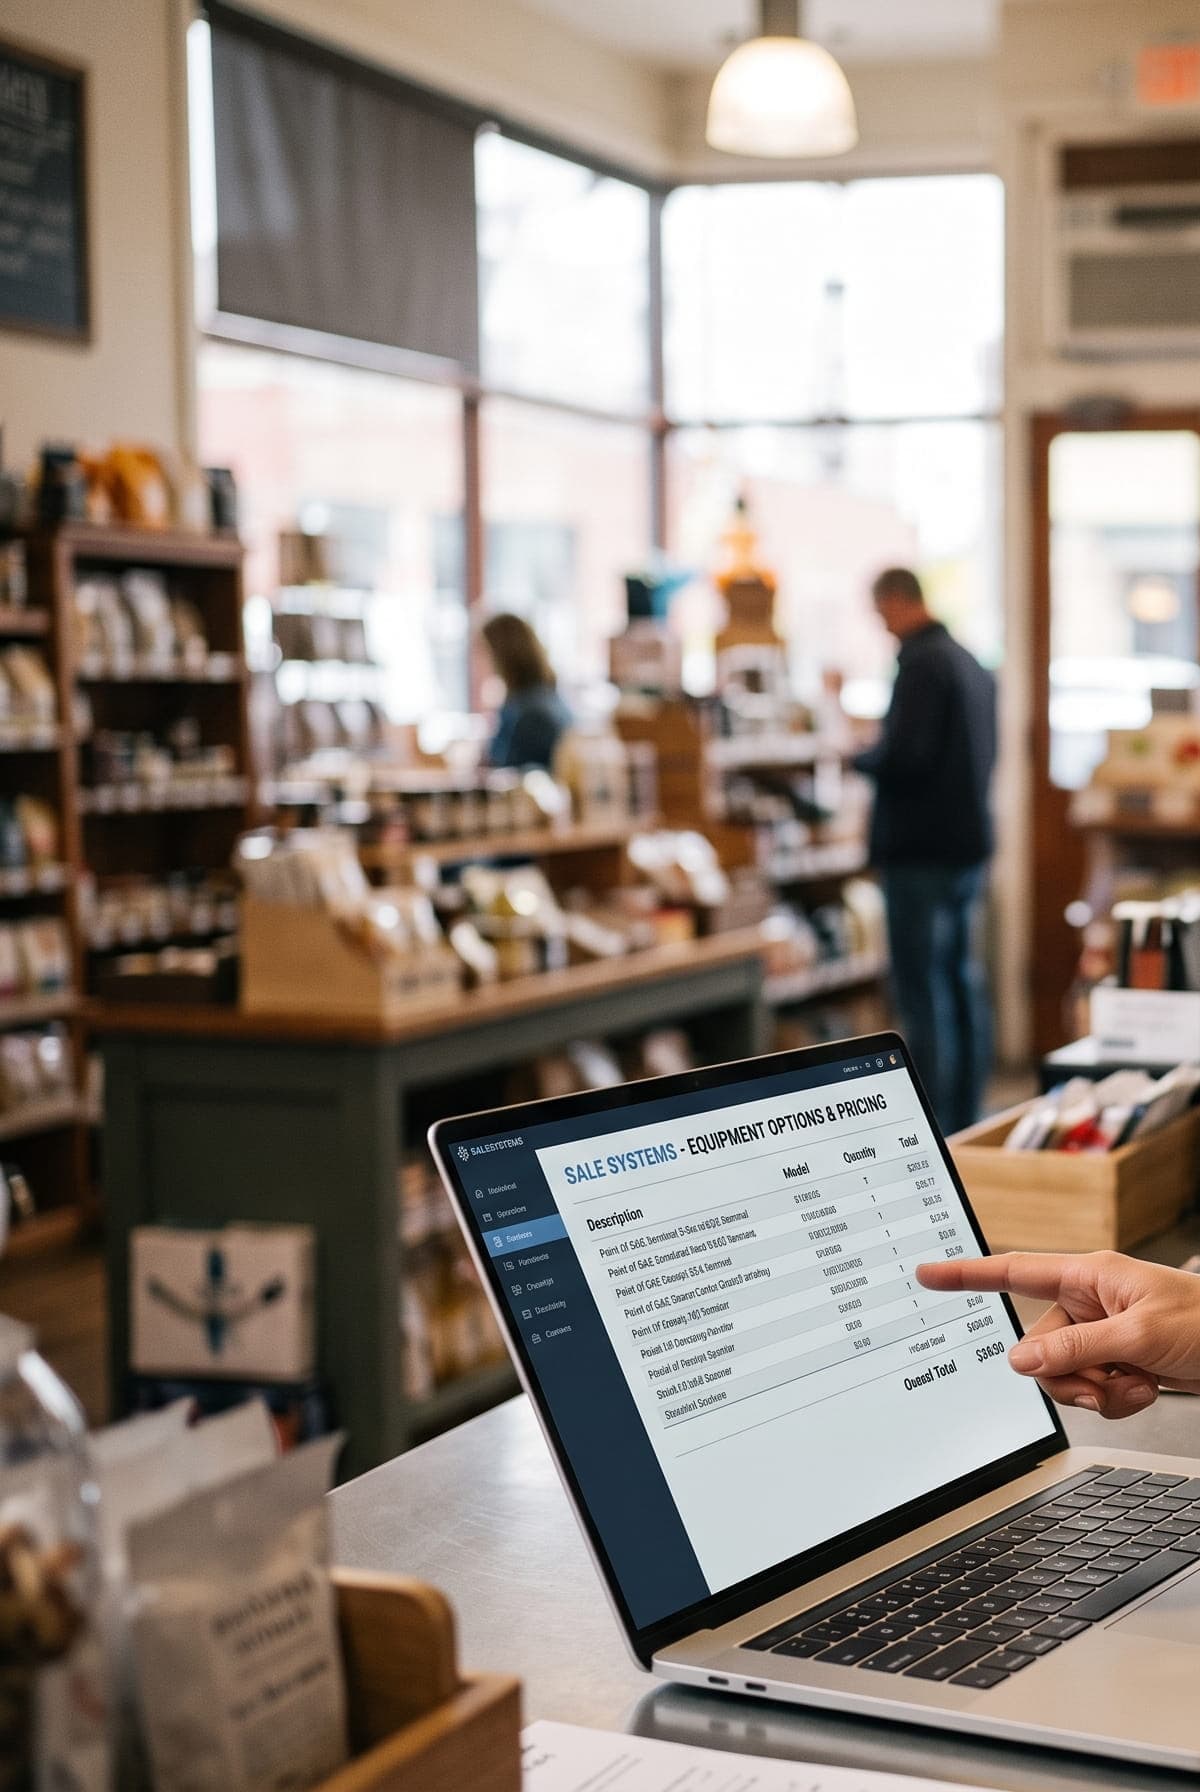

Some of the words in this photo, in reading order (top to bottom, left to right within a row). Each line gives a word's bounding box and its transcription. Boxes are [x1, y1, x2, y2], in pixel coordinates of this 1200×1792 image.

[564, 1159, 606, 1184] SALE
[607, 1143, 677, 1174] SYSTEMS
[687, 1122, 765, 1155] EQUIPMENT
[761, 1108, 825, 1135] OPTIONS
[825, 1106, 837, 1121] &
[836, 1094, 887, 1119] PRICING
[782, 1162, 810, 1179] Model
[898, 1133, 919, 1148] Total
[586, 1209, 643, 1231] Description
[933, 1359, 957, 1378] Total
